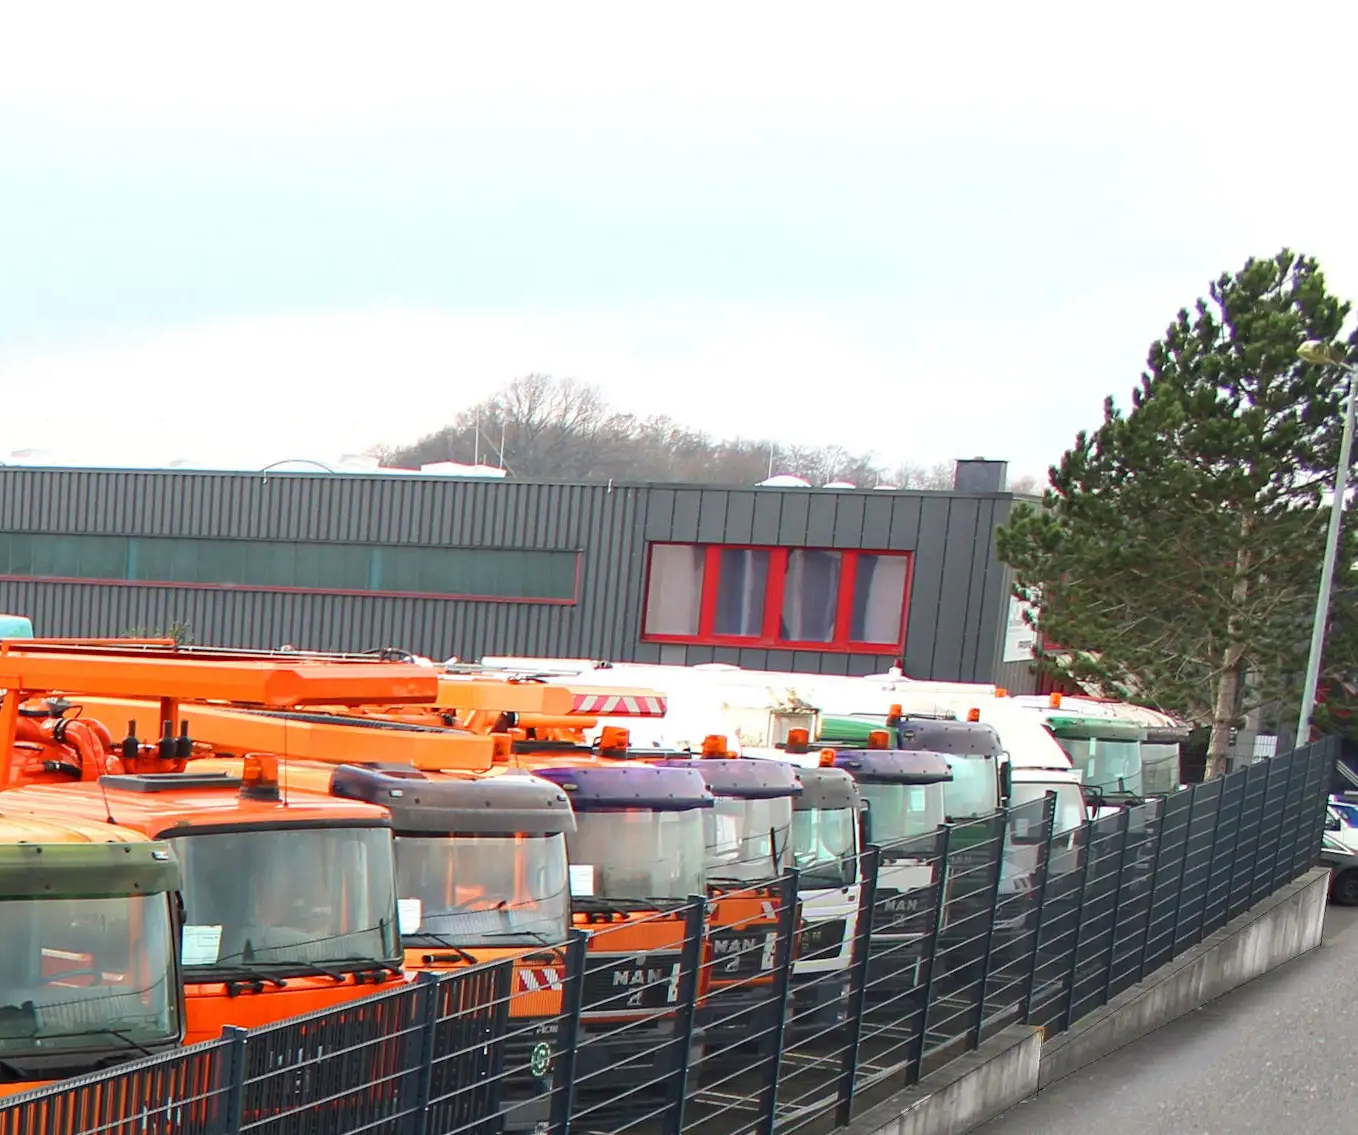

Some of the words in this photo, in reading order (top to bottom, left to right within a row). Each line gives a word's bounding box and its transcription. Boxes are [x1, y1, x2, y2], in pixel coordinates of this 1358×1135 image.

[885, 899, 918, 911] MAN
[714, 938, 758, 953] MAN
[613, 968, 664, 985] MAN
